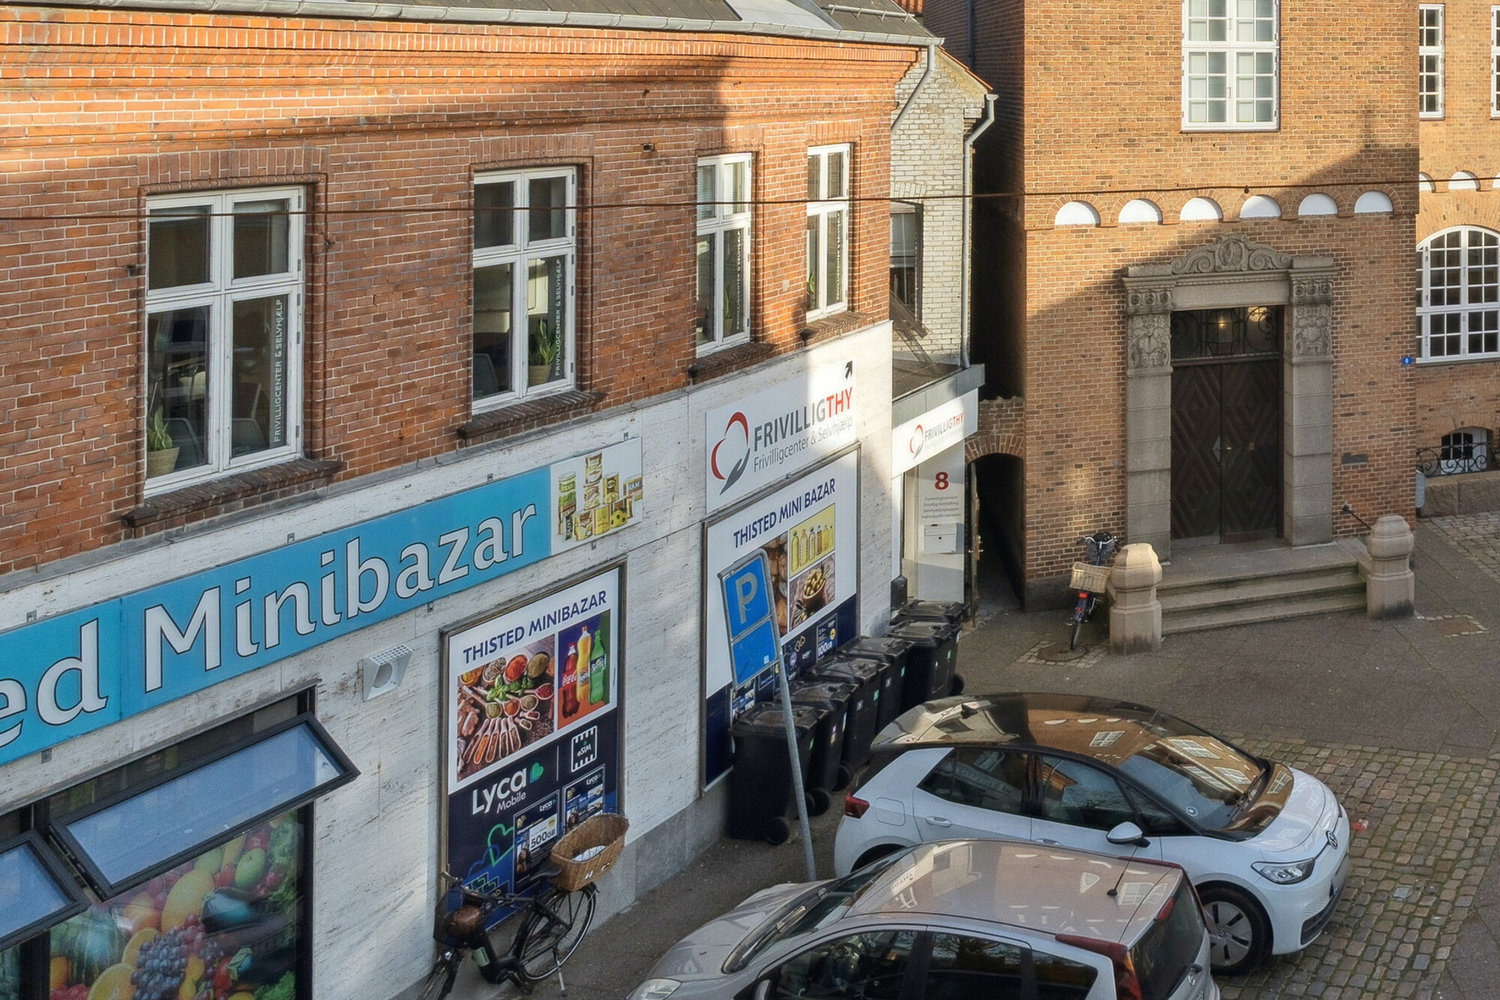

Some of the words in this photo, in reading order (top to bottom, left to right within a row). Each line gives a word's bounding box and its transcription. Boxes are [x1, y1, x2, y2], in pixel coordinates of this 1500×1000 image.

[274, 360, 282, 442] FRIVILLIGCENTER
[753, 386, 853, 452] FRIVILLIGTHY
[753, 436, 810, 473] Frivilligcenter
[810, 434, 816, 445] &
[934, 471, 949, 490] 8
[733, 511, 777, 549] THISTED
[779, 495, 802, 524] MINI
[804, 478, 836, 509] BAZAR
[144, 503, 537, 694] Minibazar
[735, 571, 758, 625] P
[463, 626, 525, 664] THISTED
[528, 590, 607, 637] MINIBAZAR
[577, 744, 592, 757] eSIM
[472, 767, 527, 816] Lyca
[496, 791, 527, 814] Mobile
